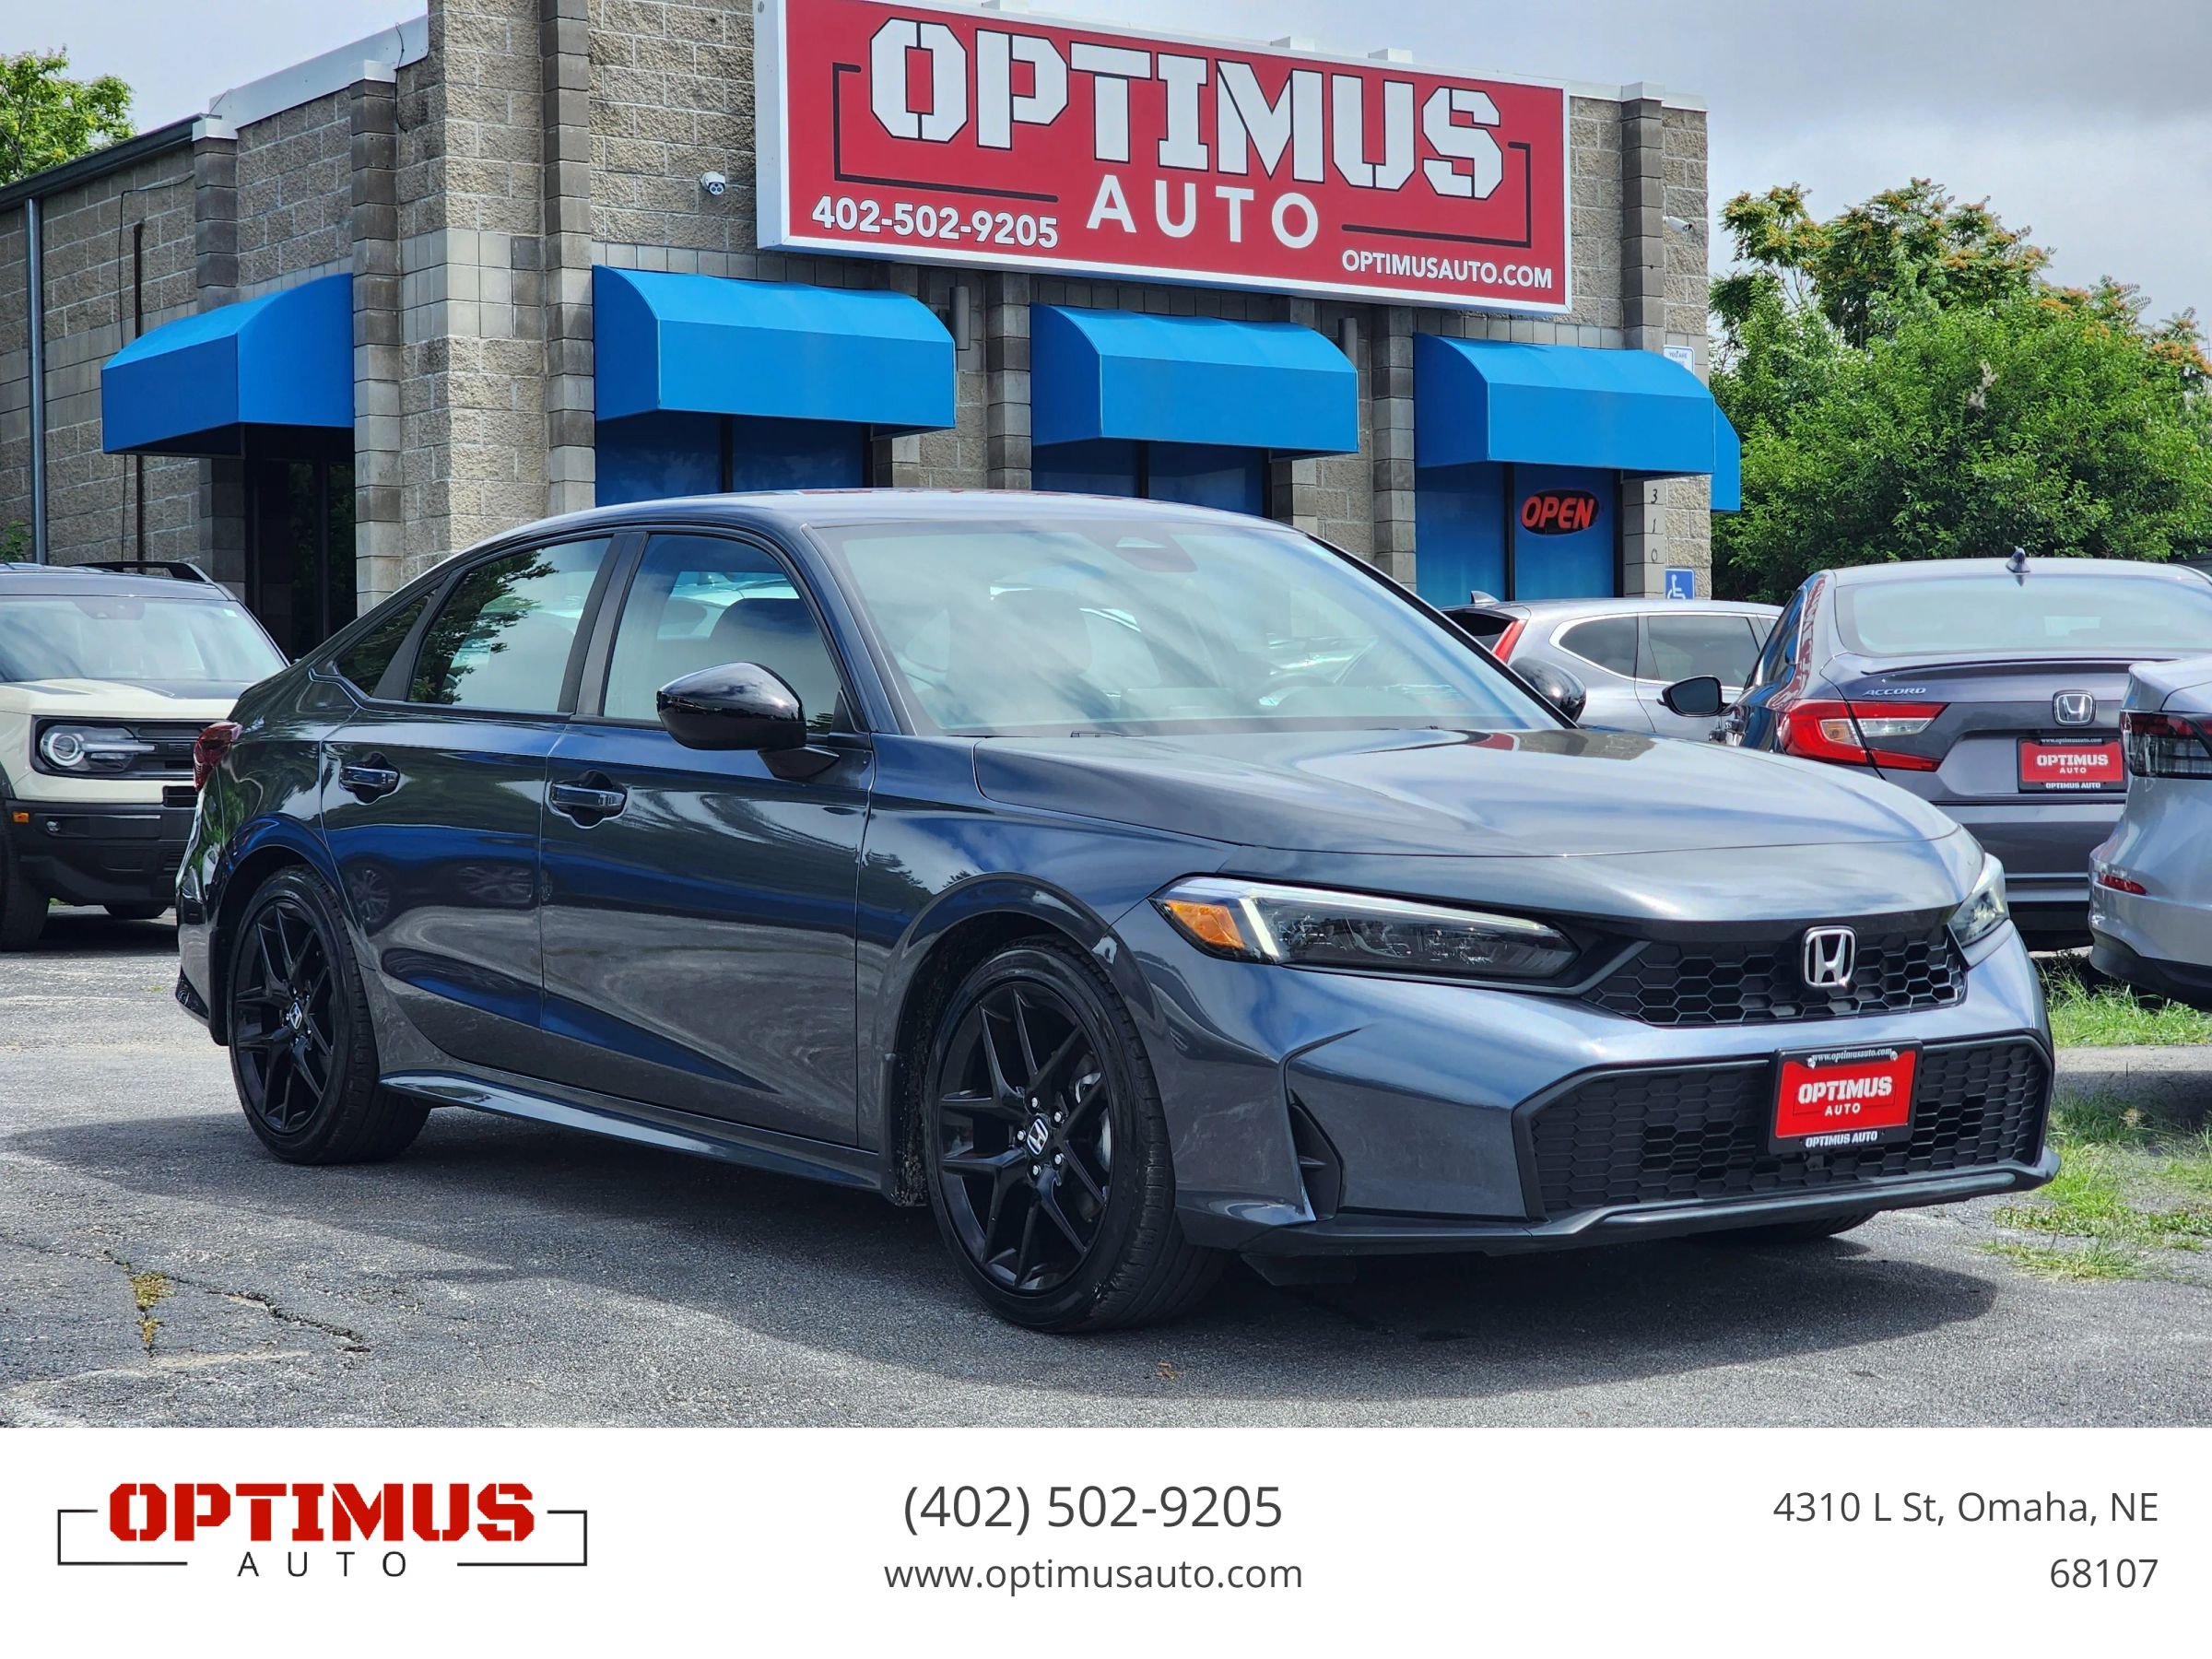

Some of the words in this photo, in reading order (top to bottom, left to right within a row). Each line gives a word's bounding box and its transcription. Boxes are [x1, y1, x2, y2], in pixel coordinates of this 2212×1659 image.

[870, 18, 1502, 199] OPTIMUS
[811, 194, 1059, 249] 402-502-9205
[1086, 174, 1318, 249] AUTO
[1341, 249, 1552, 288] OPTIMUSAUTO.COM
[1521, 495, 1595, 530] OPEN
[1862, 688, 1926, 697] ACCORD
[2036, 754, 2109, 767] OPTIMUS
[1798, 1076, 1892, 1104] OPTIMUS
[1824, 1102, 1861, 1116] AUTO
[1806, 1134, 1850, 1148] OPTIMUS
[1852, 1130, 1877, 1143] AUTO
